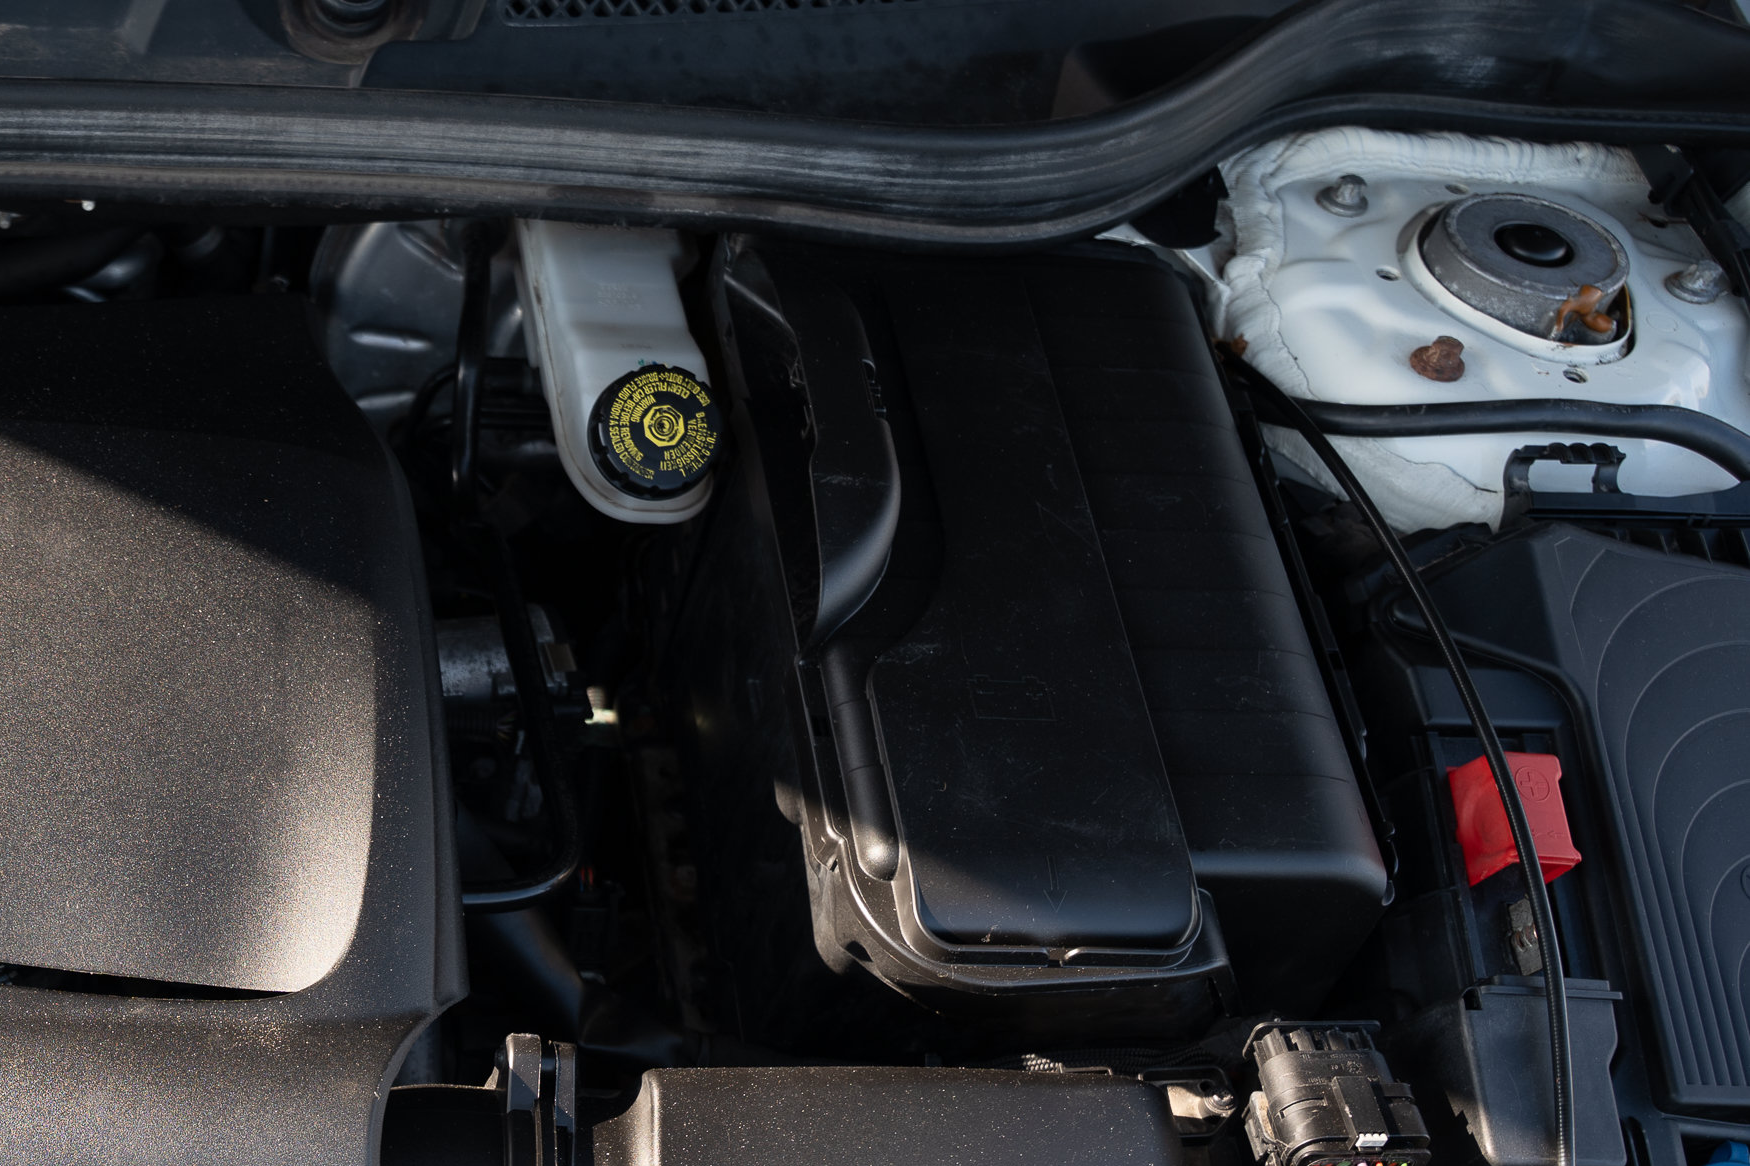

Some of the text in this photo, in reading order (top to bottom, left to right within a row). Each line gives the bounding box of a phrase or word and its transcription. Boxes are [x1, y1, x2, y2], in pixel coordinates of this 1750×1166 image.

[618, 381, 638, 400] FLUID
[632, 388, 645, 403] CAP
[643, 381, 668, 395] FILLER
[609, 398, 625, 419] FROM
[619, 399, 636, 427] BEFORE
[630, 394, 657, 423] WARNING
[609, 426, 625, 454] SEALED
